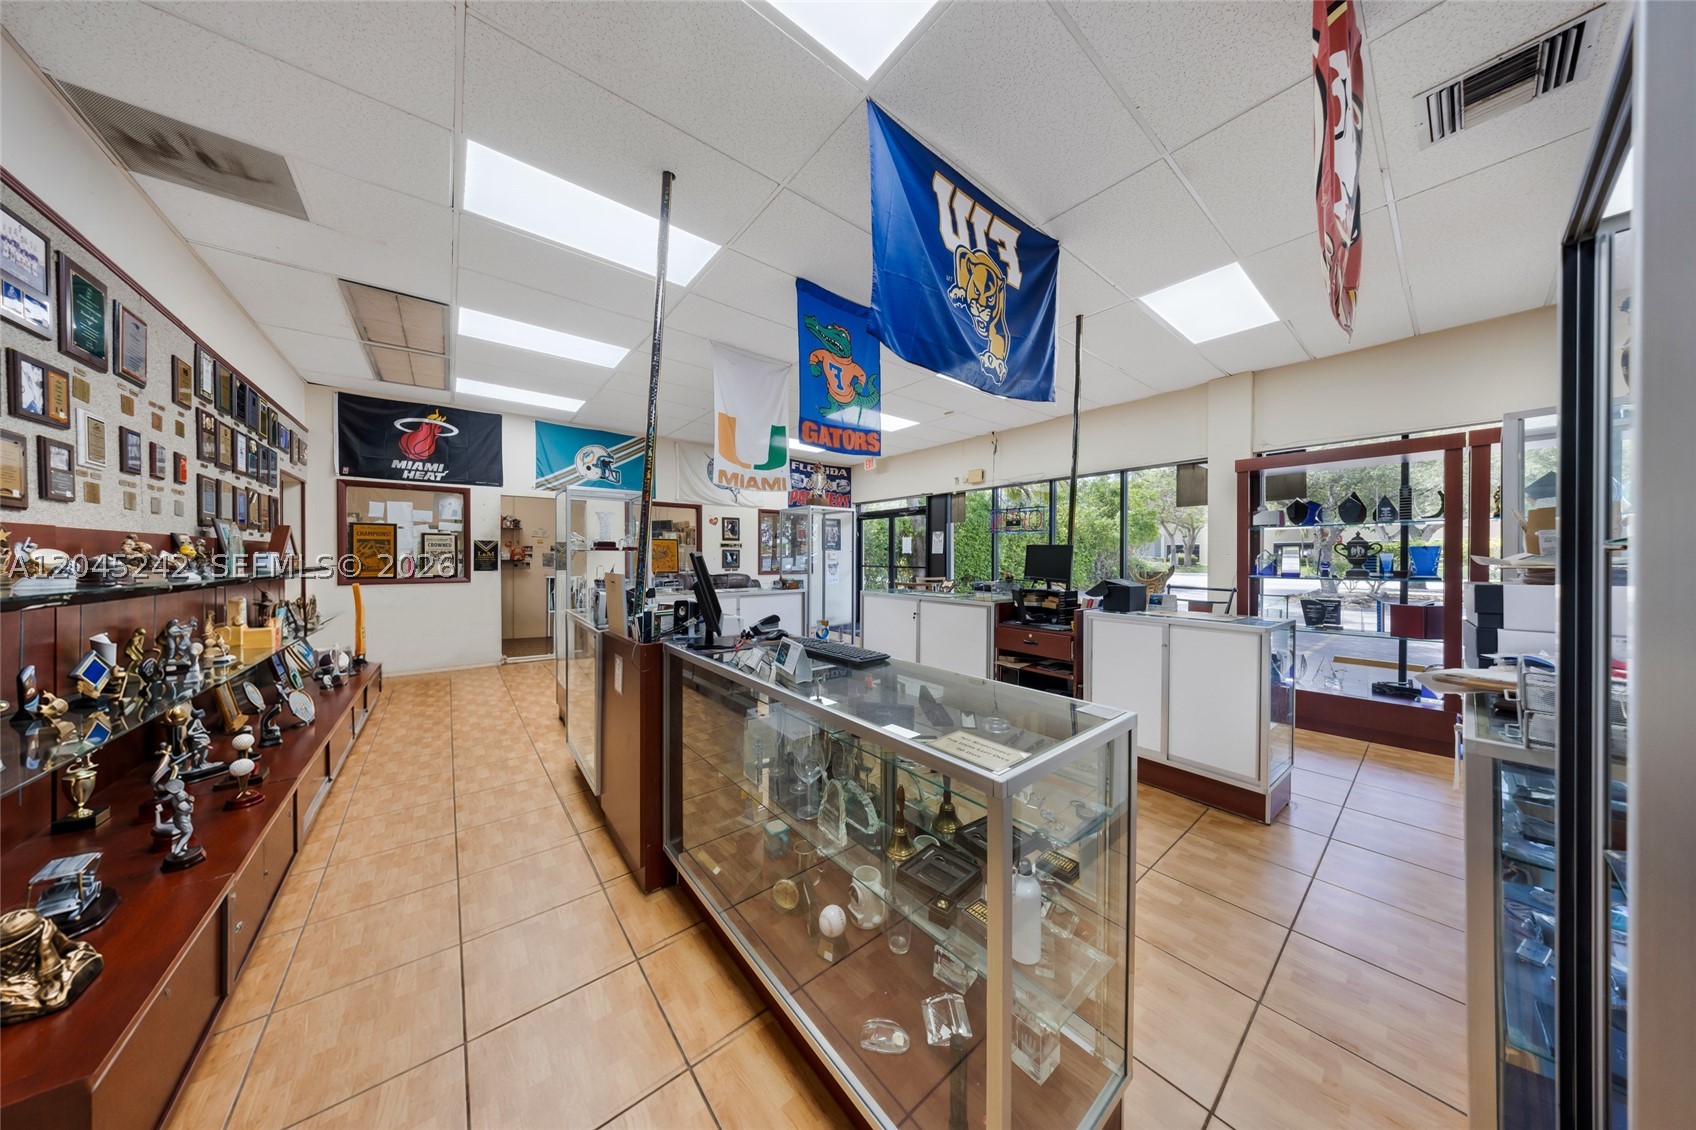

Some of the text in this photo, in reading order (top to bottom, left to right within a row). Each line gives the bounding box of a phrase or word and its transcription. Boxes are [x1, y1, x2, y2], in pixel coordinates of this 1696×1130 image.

[801, 420, 881, 453] GATORS
[391, 459, 445, 472] MIAMI
[402, 470, 449, 481] HEAT
[718, 469, 787, 492] MIAMI
